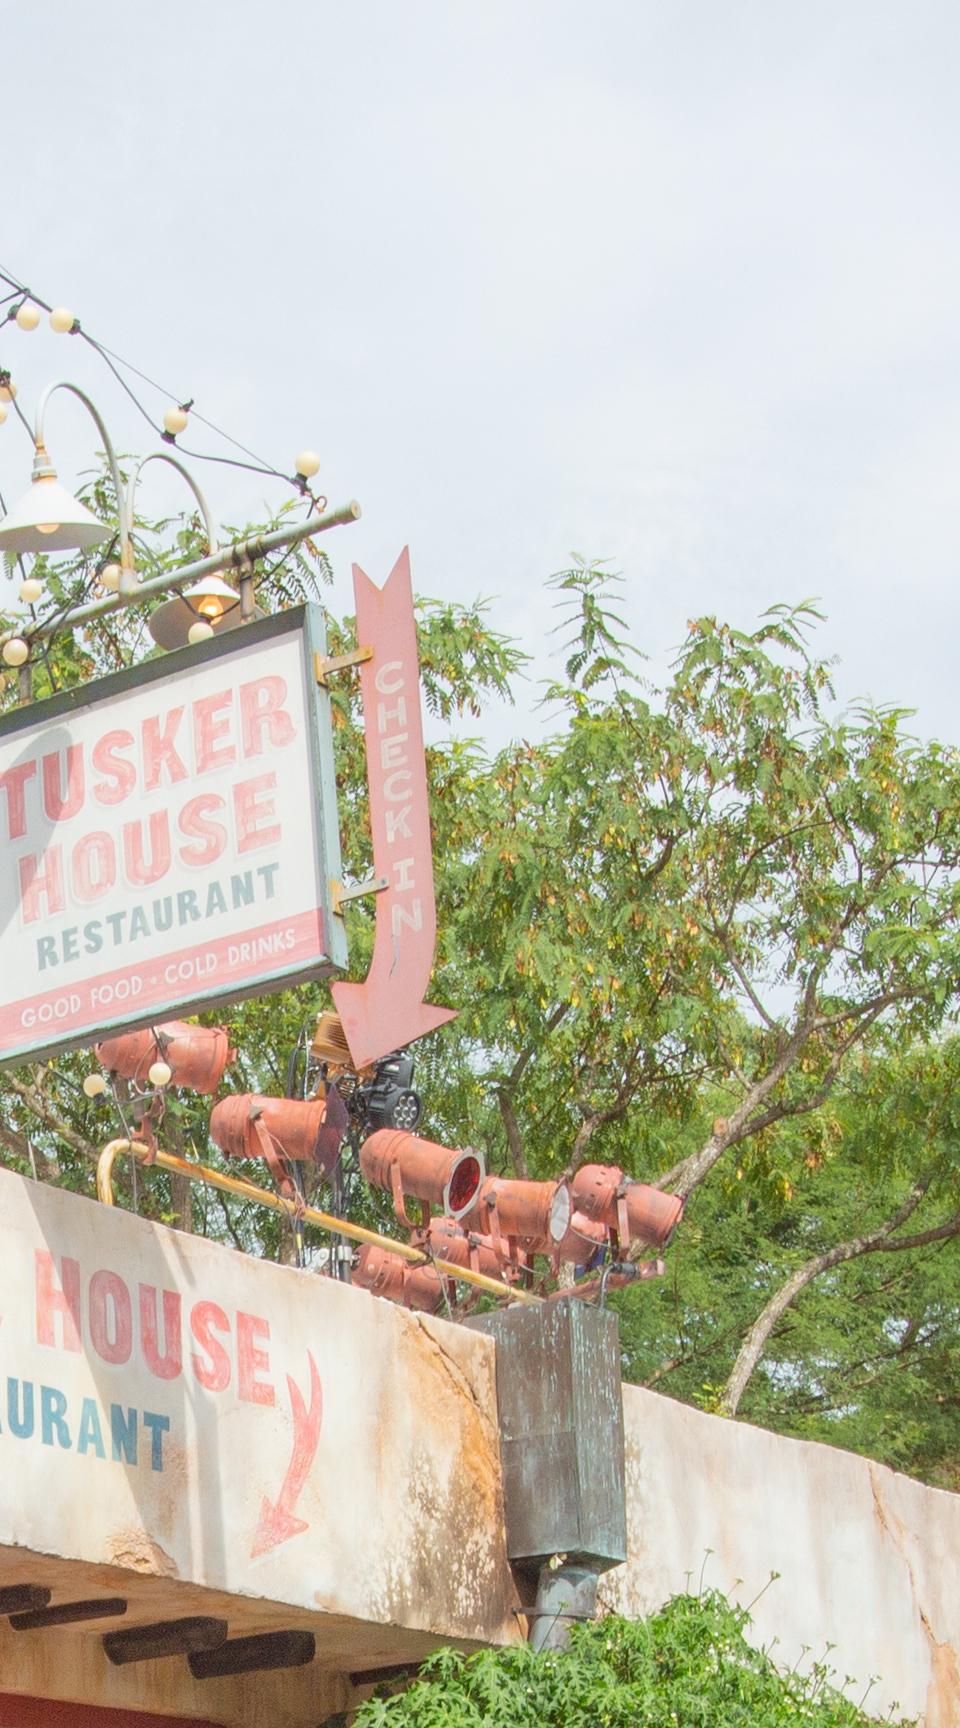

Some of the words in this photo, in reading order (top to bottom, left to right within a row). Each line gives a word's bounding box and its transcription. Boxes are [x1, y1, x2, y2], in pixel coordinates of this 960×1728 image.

[375, 661, 413, 843] CHECK
[18, 772, 283, 925] HOUSE
[391, 858, 423, 936] IN
[21, 996, 81, 1028] GOOD
[91, 975, 143, 1008] FOOD
[164, 953, 217, 984] COLD
[228, 929, 296, 966] DRINKS
[37, 863, 280, 971] RESTAURANT
[35, 1249, 276, 1406] HOUSE
